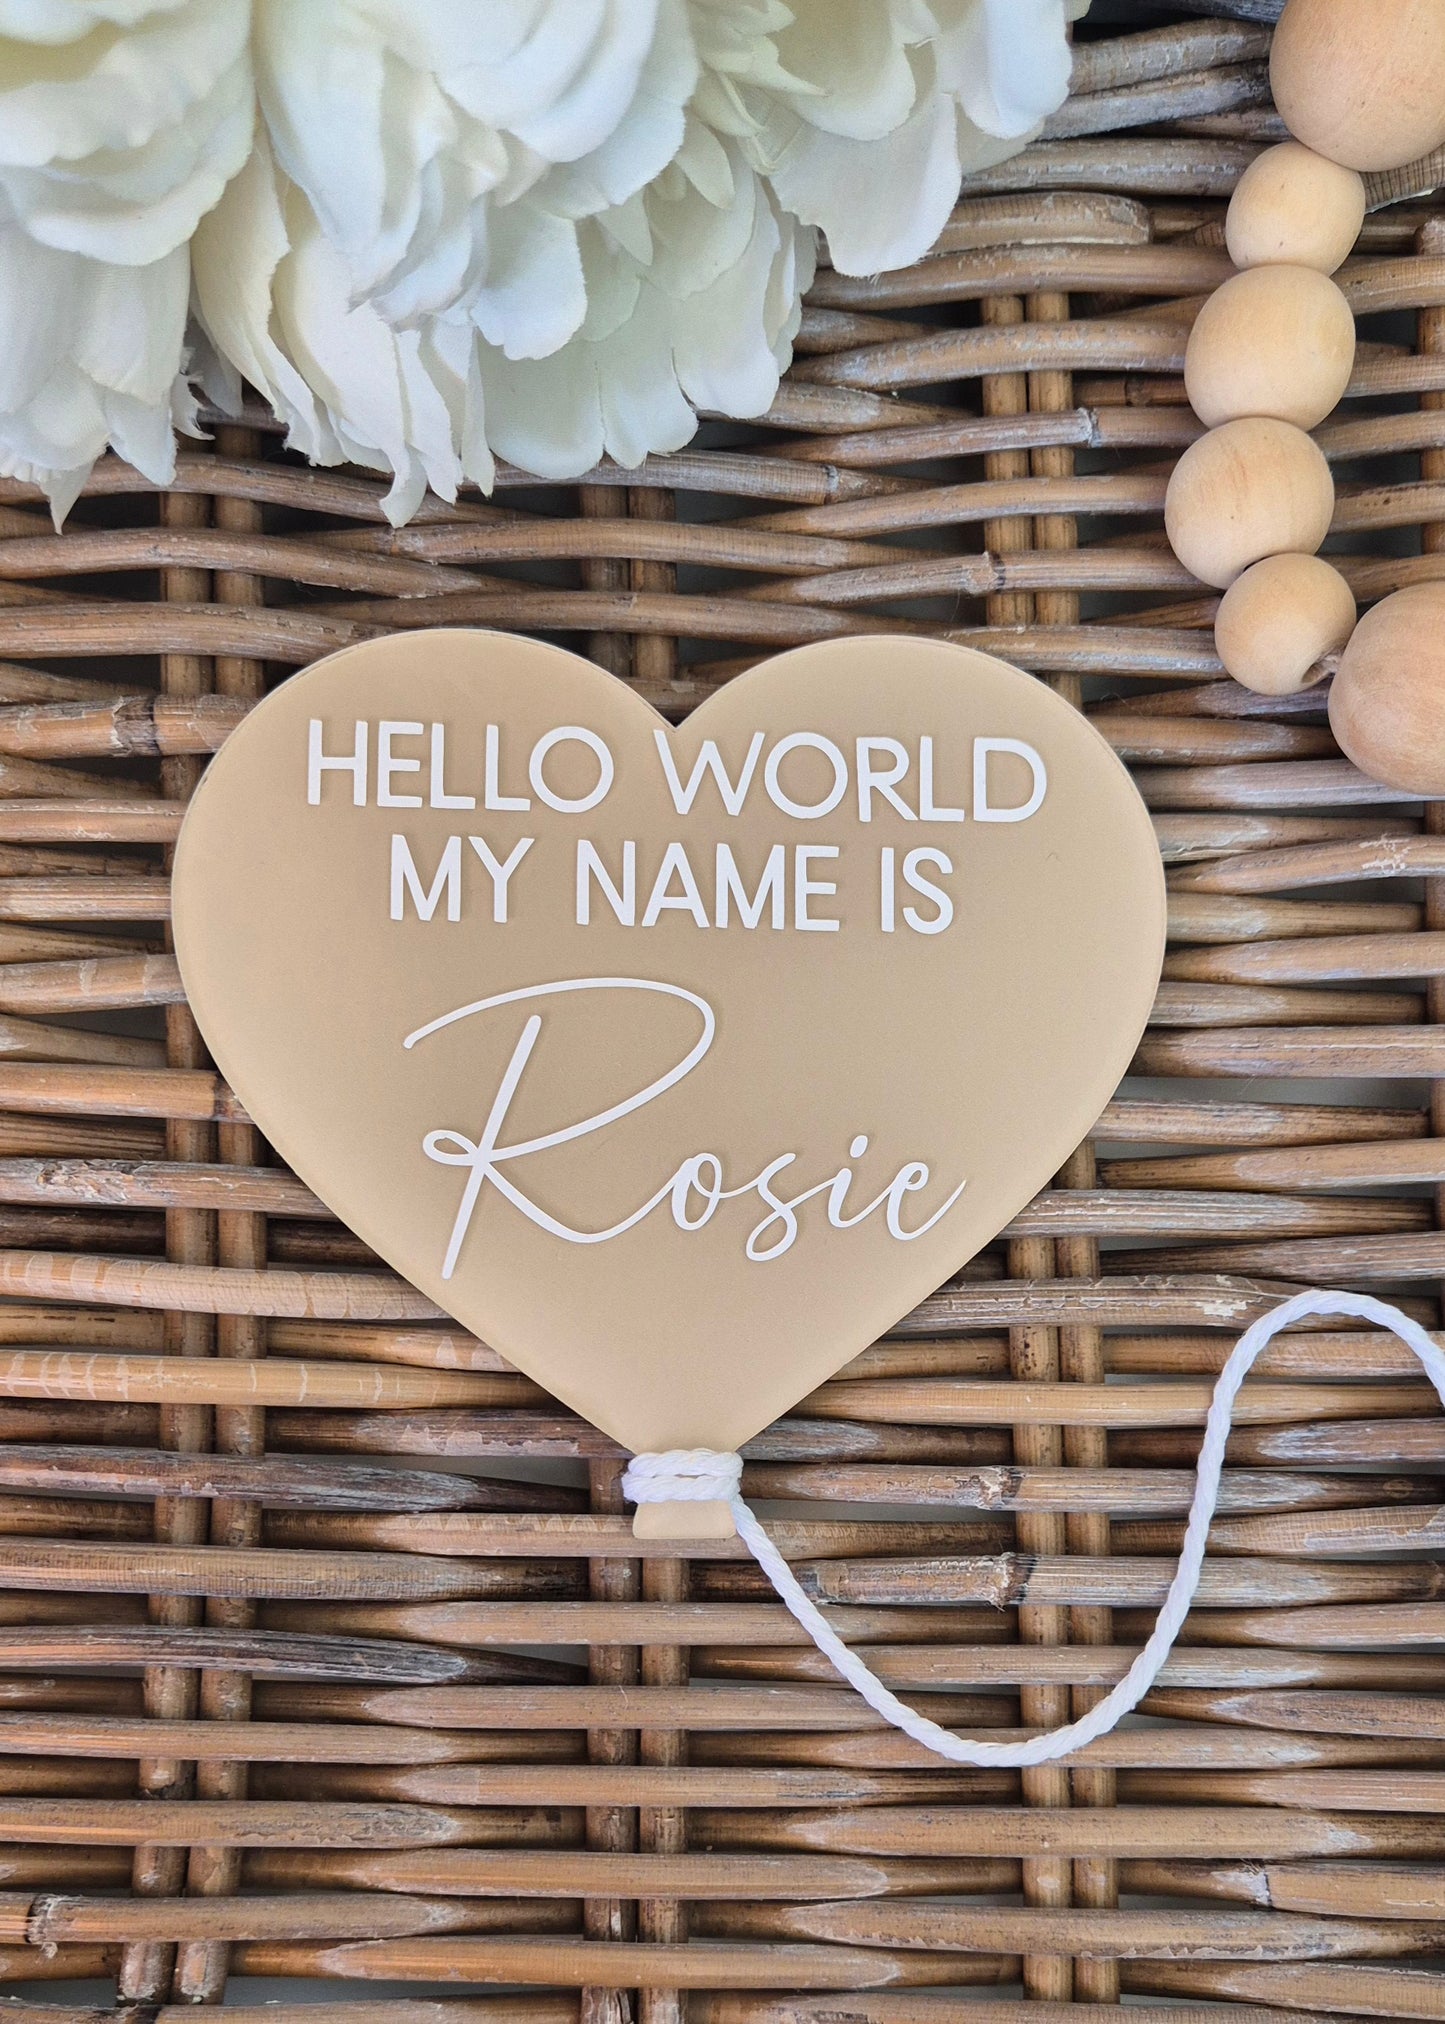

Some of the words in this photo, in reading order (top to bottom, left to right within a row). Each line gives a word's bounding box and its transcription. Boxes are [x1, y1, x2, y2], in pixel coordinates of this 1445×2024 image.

[306, 718, 615, 814] HELLO
[652, 727, 1048, 823] WORLD
[389, 833, 536, 924] MY
[576, 839, 840, 933] NAME
[881, 846, 954, 935] IS
[402, 977, 967, 1281] Rosie
